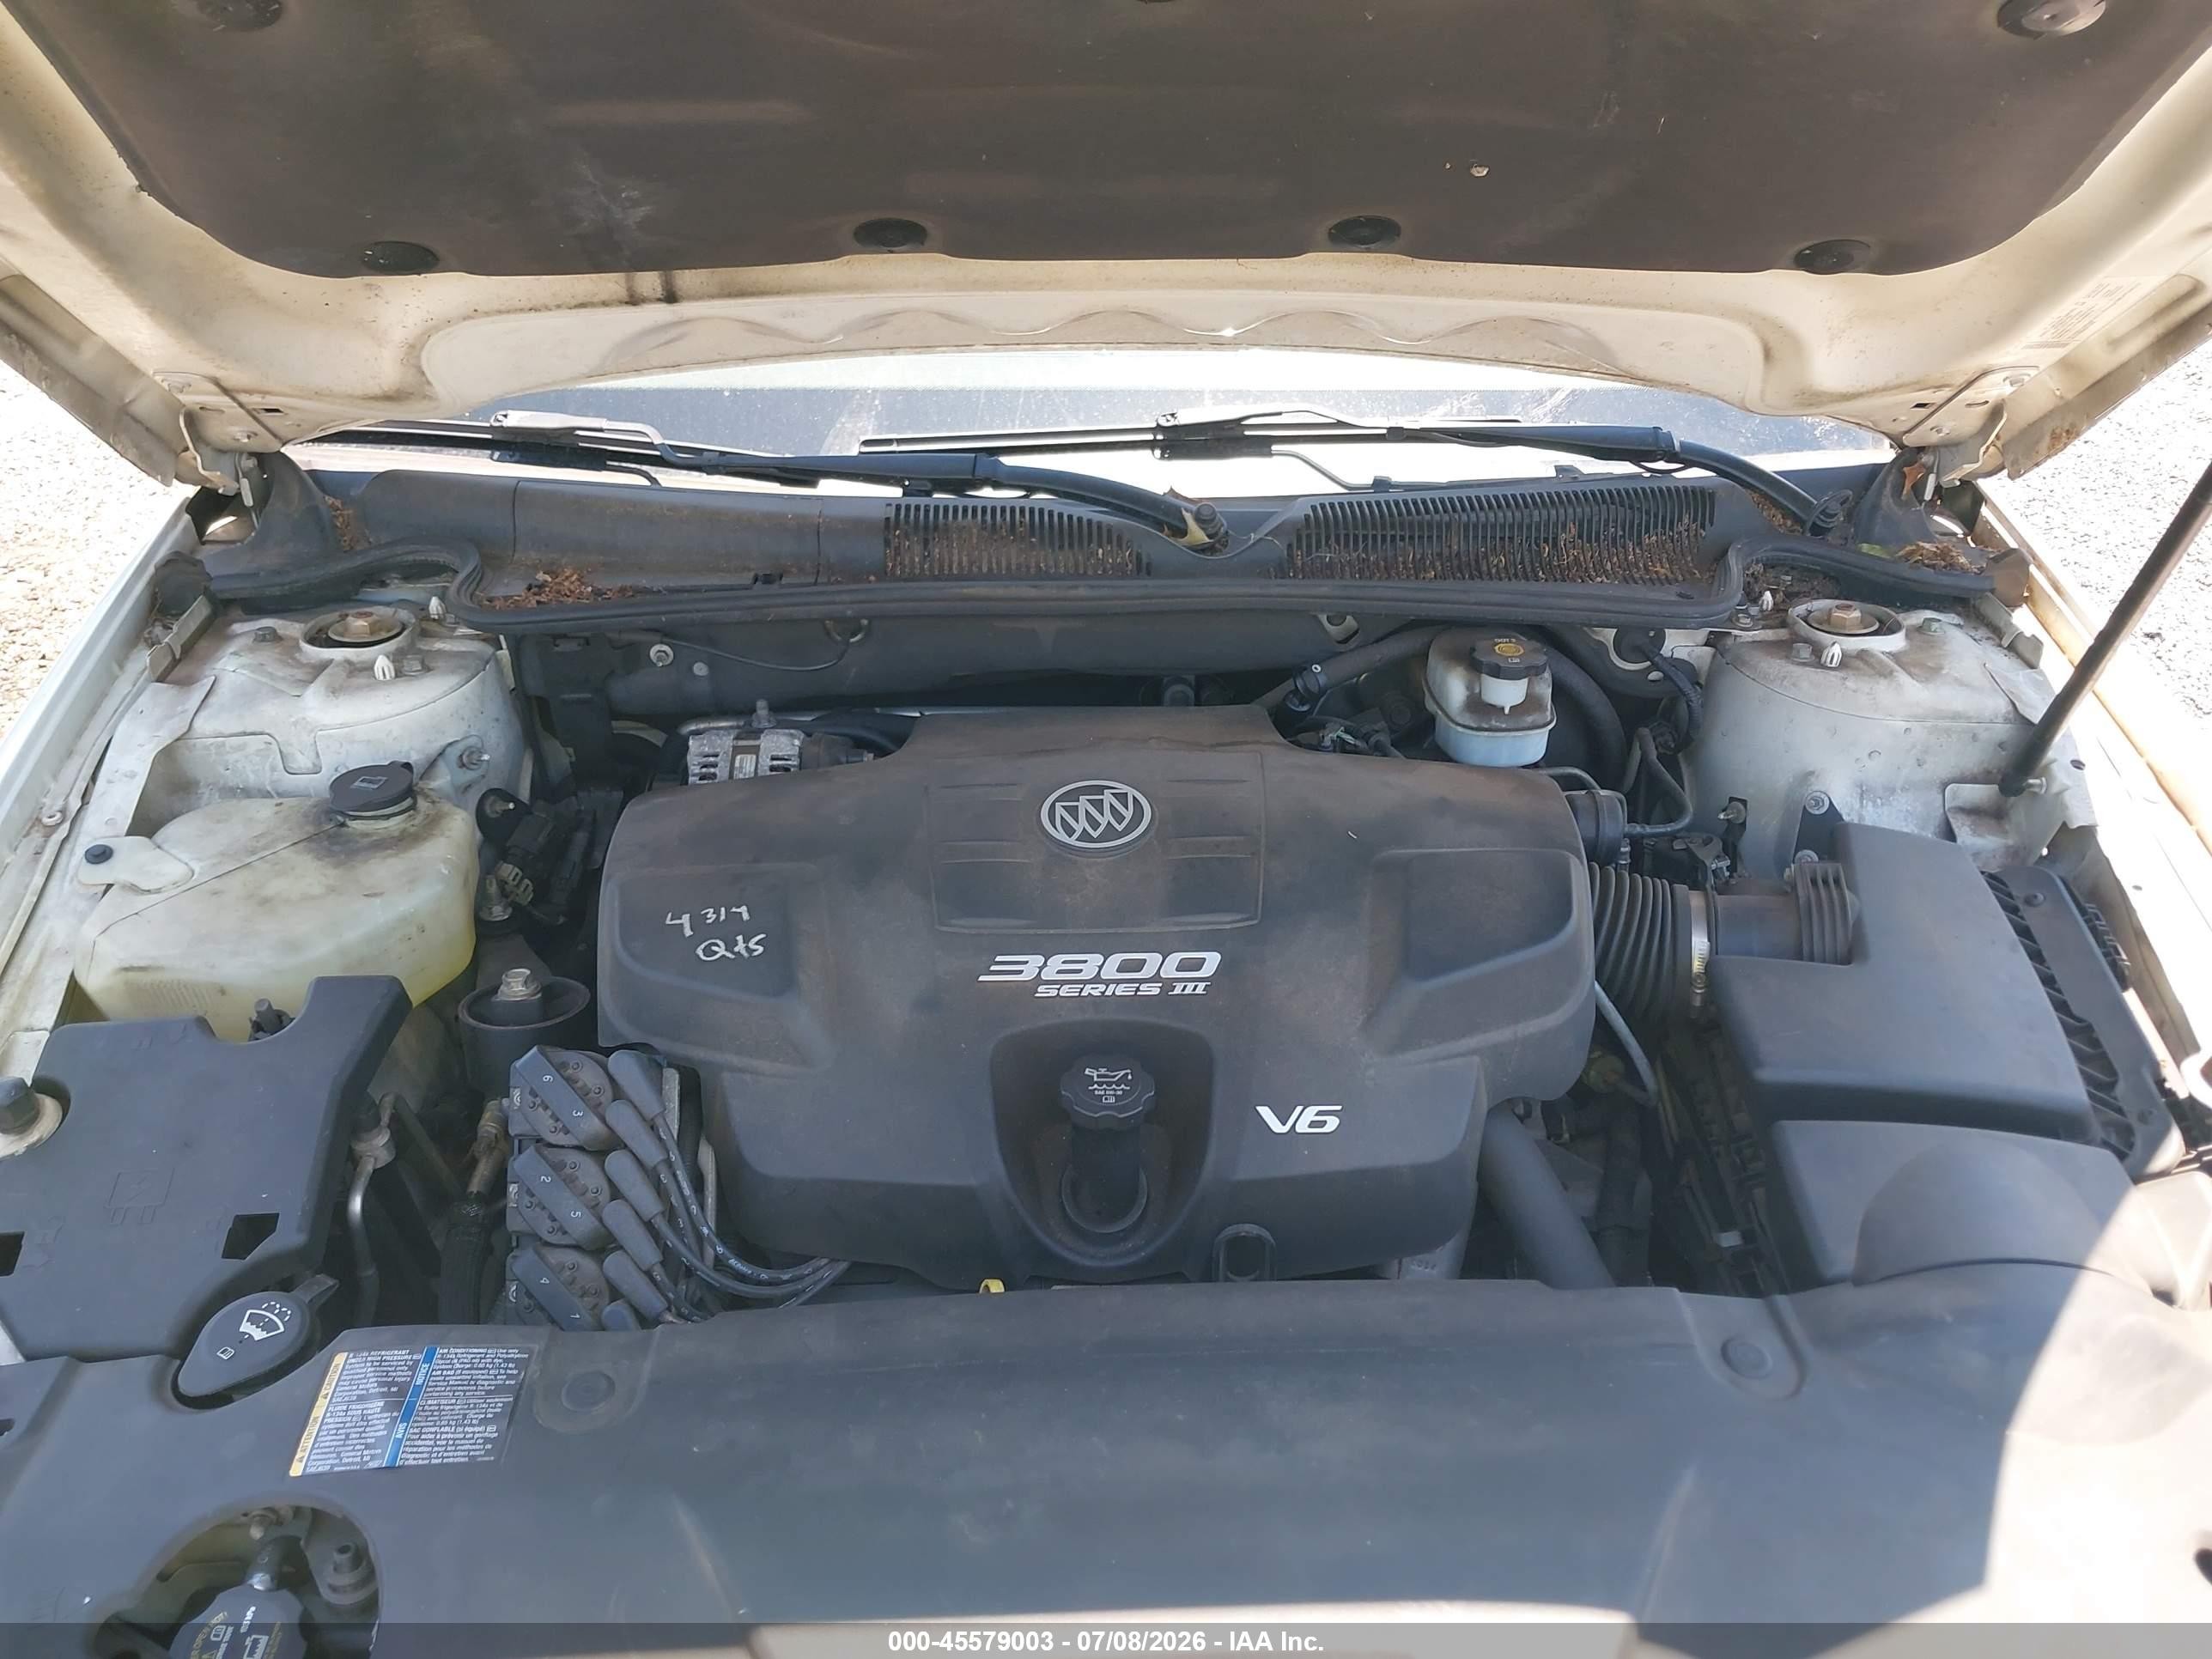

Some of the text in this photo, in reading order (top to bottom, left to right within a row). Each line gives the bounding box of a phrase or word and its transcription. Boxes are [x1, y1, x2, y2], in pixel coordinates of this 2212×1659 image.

[977, 951, 1221, 981] 3800
[1034, 981, 1211, 997] SERIES III
[1255, 1105, 1343, 1133] V6
[415, 1362, 431, 1386] NOTICE
[396, 1422, 408, 1438] AVIS
